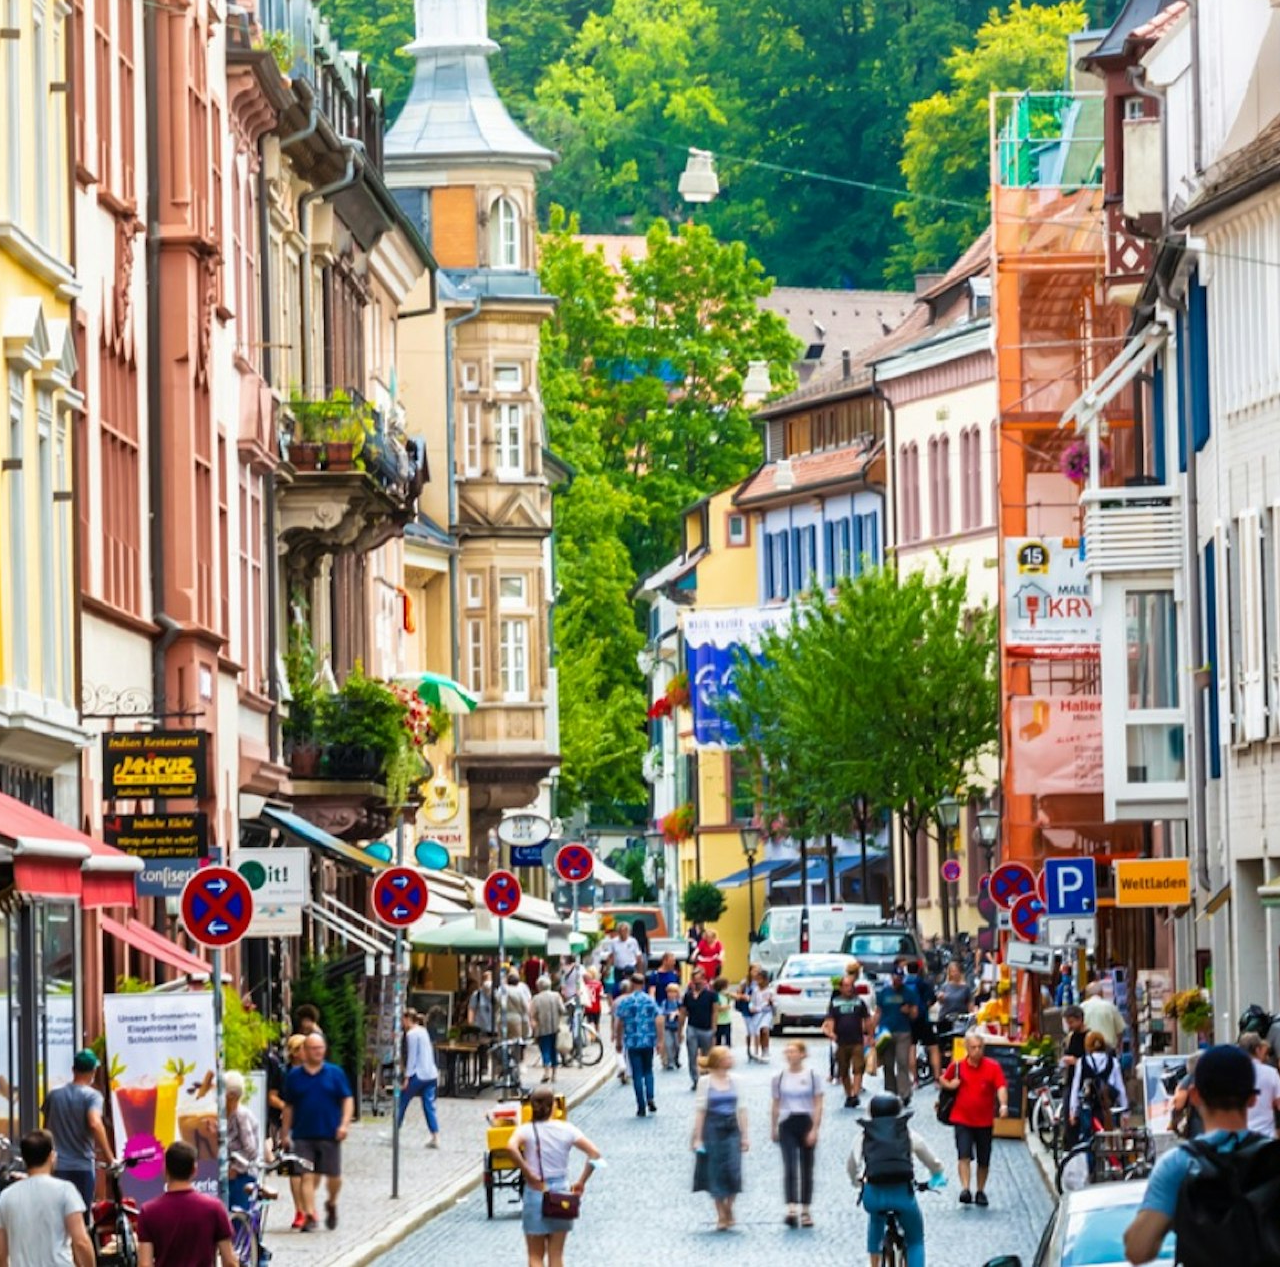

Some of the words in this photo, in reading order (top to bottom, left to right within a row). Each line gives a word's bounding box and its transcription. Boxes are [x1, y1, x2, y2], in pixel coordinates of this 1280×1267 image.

[1023, 547, 1044, 565] 15
[1058, 585, 1090, 595] MALE
[1049, 597, 1092, 618] KRY
[109, 736, 141, 749] Indian
[144, 736, 199, 748] Restaurant
[133, 817, 166, 829] Indische
[268, 865, 289, 883] it!
[1057, 866, 1084, 909] P
[1121, 876, 1187, 891] Weltladen
